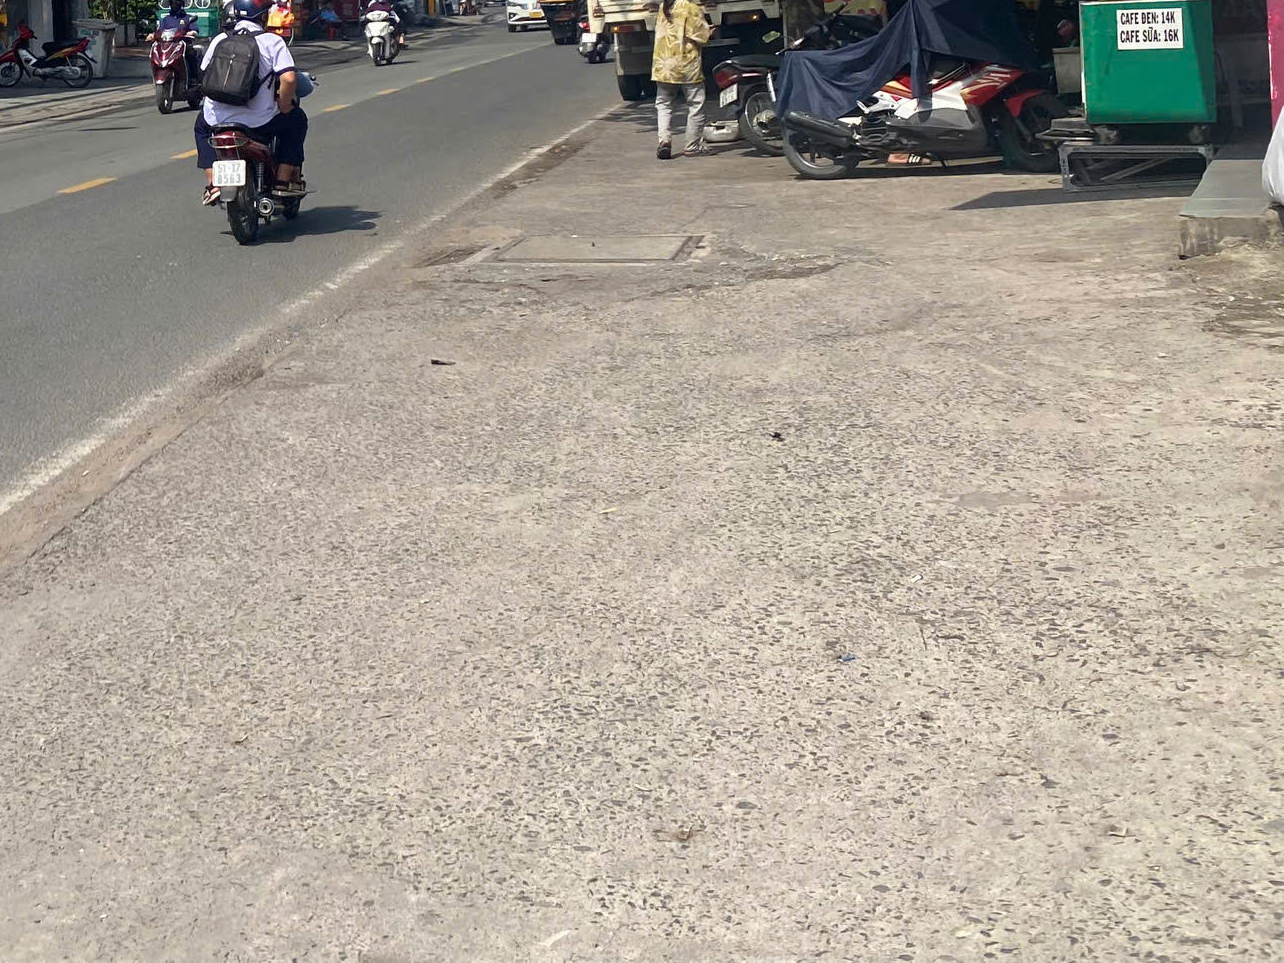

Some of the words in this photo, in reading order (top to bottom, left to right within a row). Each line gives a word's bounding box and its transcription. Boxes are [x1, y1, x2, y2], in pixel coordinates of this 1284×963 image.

[1120, 12, 1139, 25] CAFE
[1161, 11, 1175, 24] 14K
[1120, 30, 1140, 43] CAFE
[1164, 29, 1179, 42] 16K
